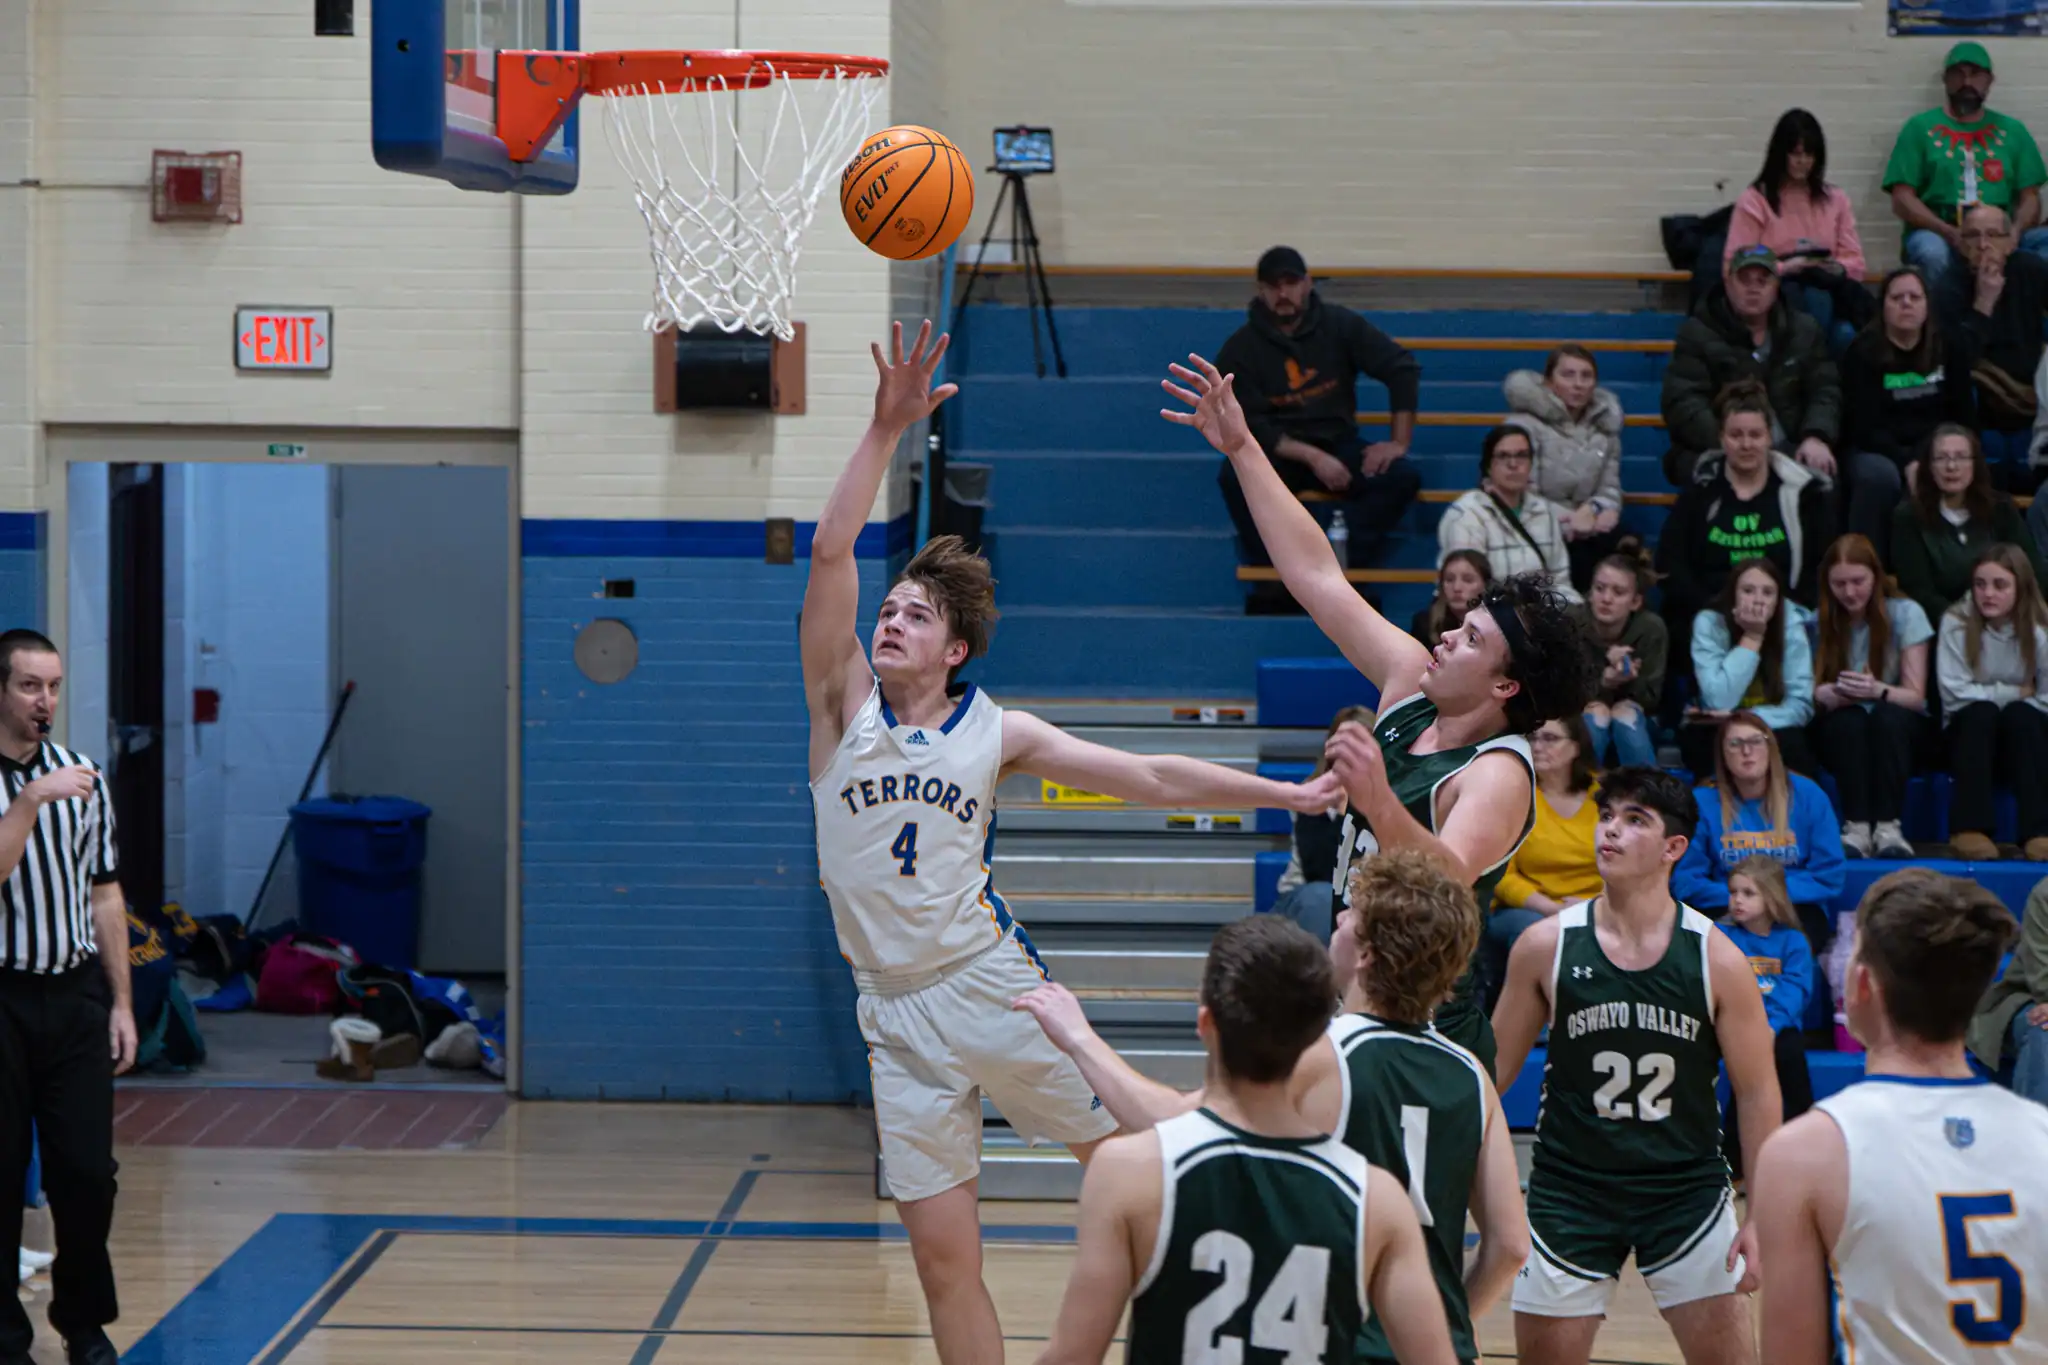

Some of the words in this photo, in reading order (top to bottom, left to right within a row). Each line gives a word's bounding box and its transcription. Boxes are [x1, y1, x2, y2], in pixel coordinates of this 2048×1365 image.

[253, 315, 316, 364] EXIT
[840, 773, 979, 824] TERRORS
[890, 821, 918, 878] 4
[1567, 1001, 1630, 1039] OSWAYO
[1636, 1002, 1701, 1042] VALLEY
[1592, 1051, 1676, 1121] 22
[1401, 1104, 1435, 1227] 1
[1177, 1229, 1331, 1365] 24
[1936, 1190, 2026, 1348] 5
